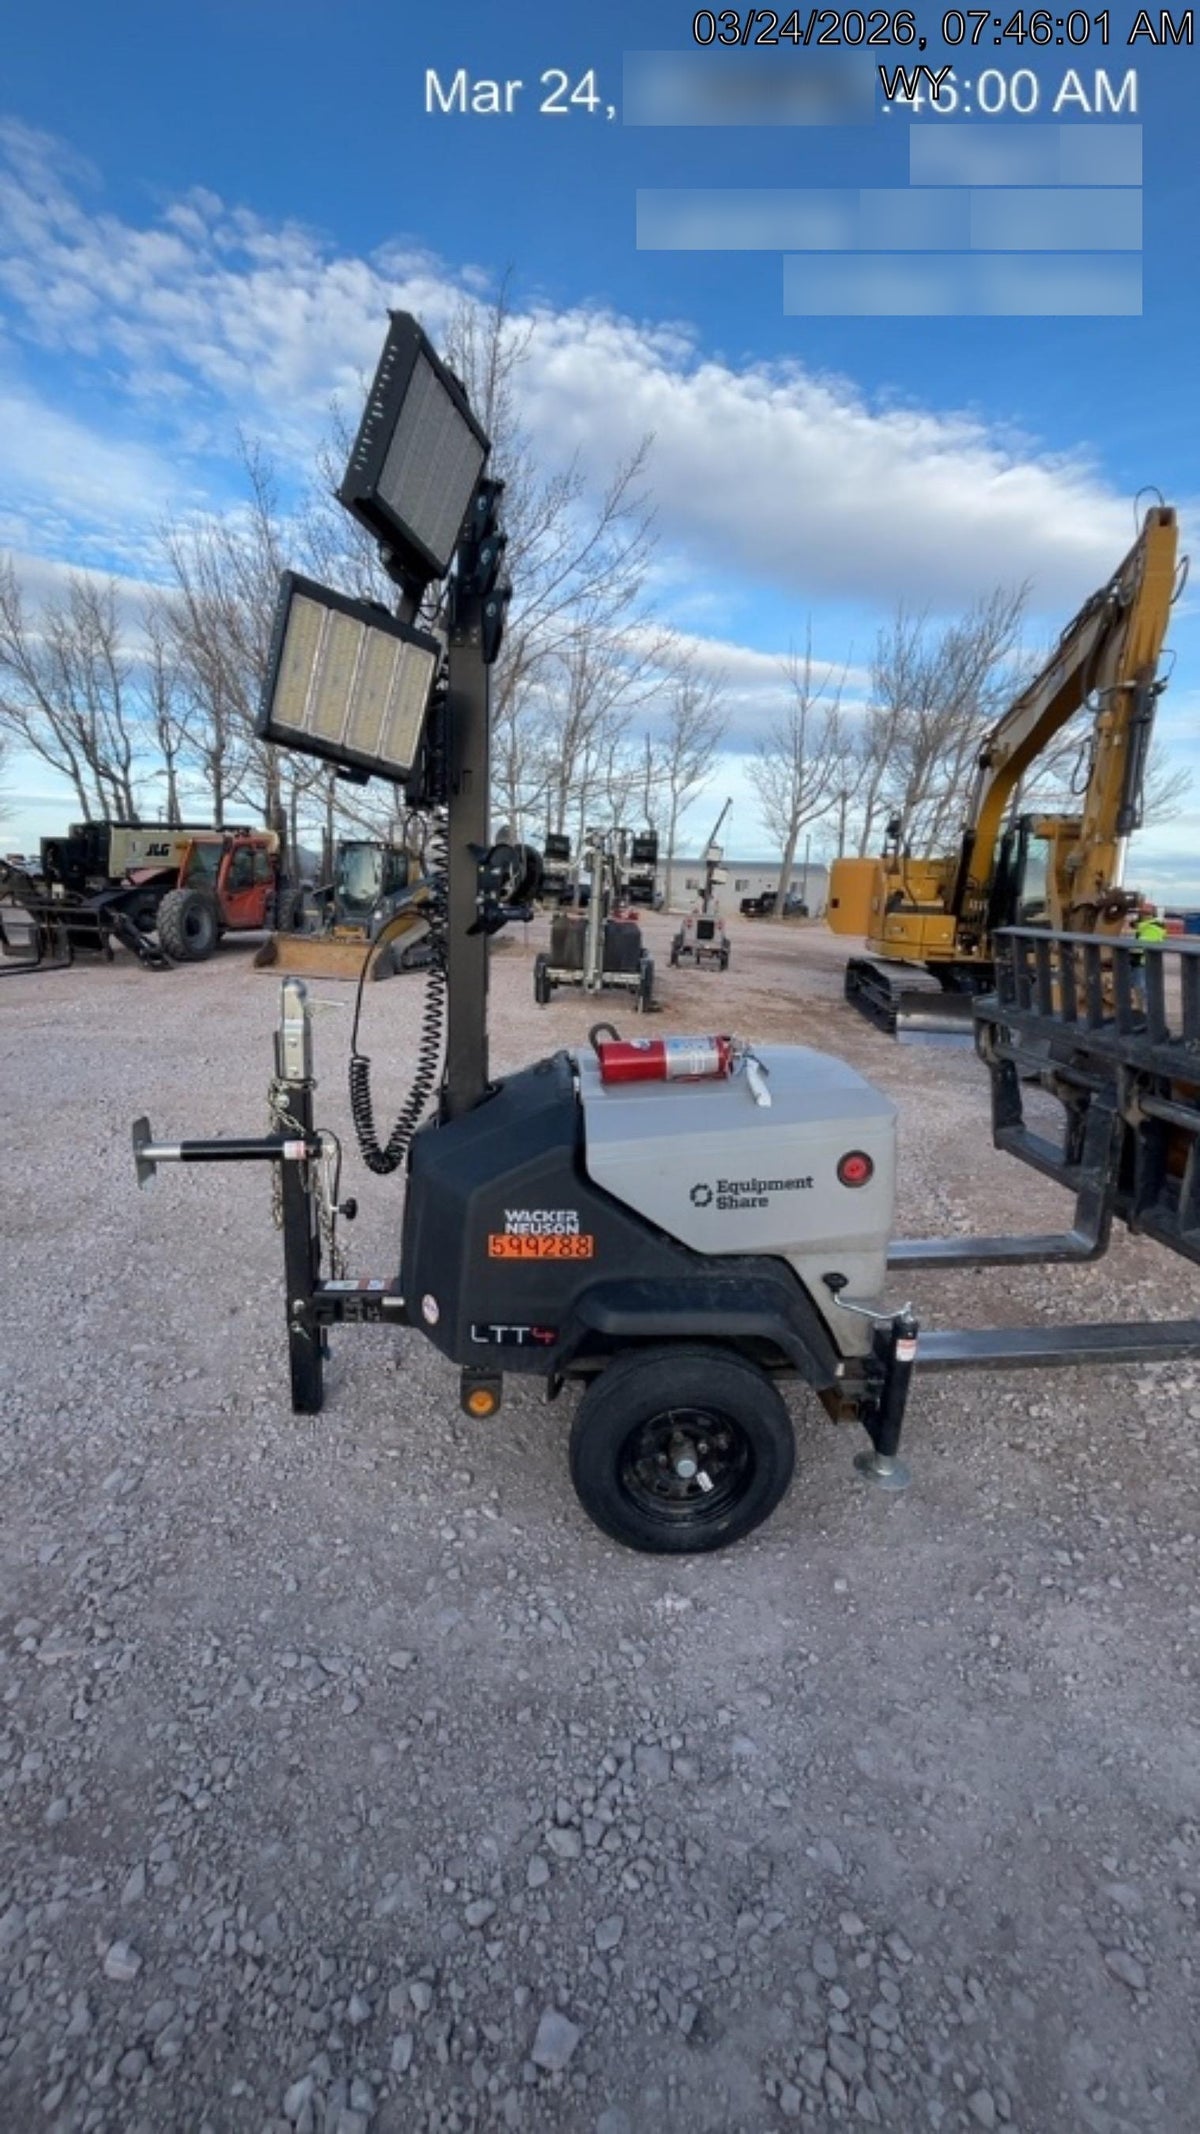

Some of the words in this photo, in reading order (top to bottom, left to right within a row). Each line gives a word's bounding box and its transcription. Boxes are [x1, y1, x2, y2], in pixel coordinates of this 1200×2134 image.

[145, 843, 171, 857] JLG
[716, 1176, 814, 1196] Equipment
[716, 1195, 769, 1211] Share
[504, 1209, 579, 1222] WACKER
[504, 1223, 579, 1235] NEUSON
[491, 1236, 590, 1256] 599288
